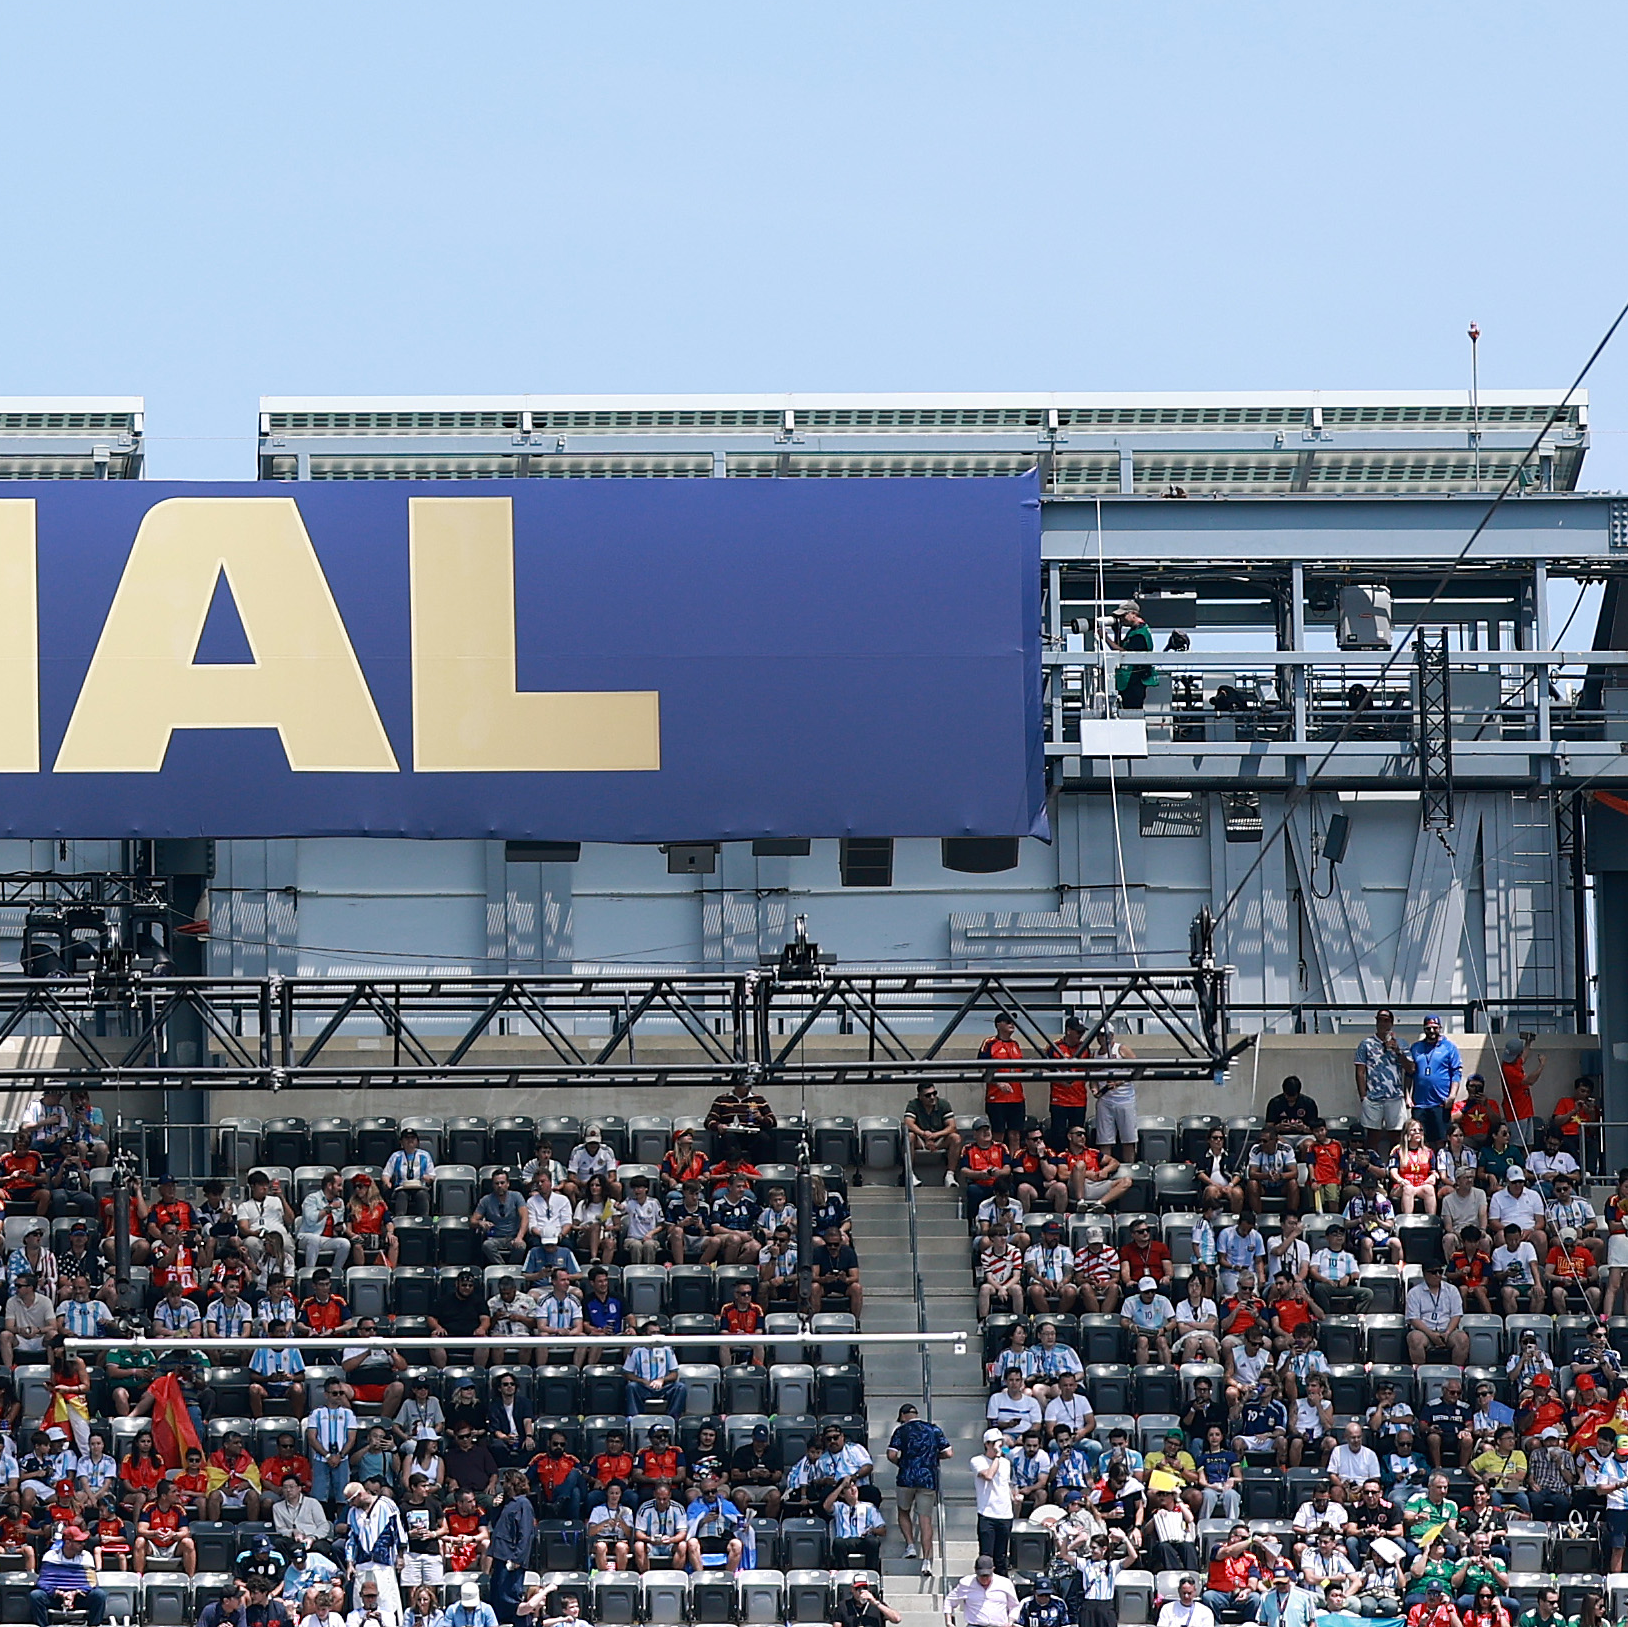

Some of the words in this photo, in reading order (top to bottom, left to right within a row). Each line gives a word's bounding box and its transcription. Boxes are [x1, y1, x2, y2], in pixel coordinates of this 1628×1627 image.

[1329, 1258, 1338, 1268] 10
[1145, 1311, 1153, 1320] 10
[1247, 1410, 1258, 1422] 19
